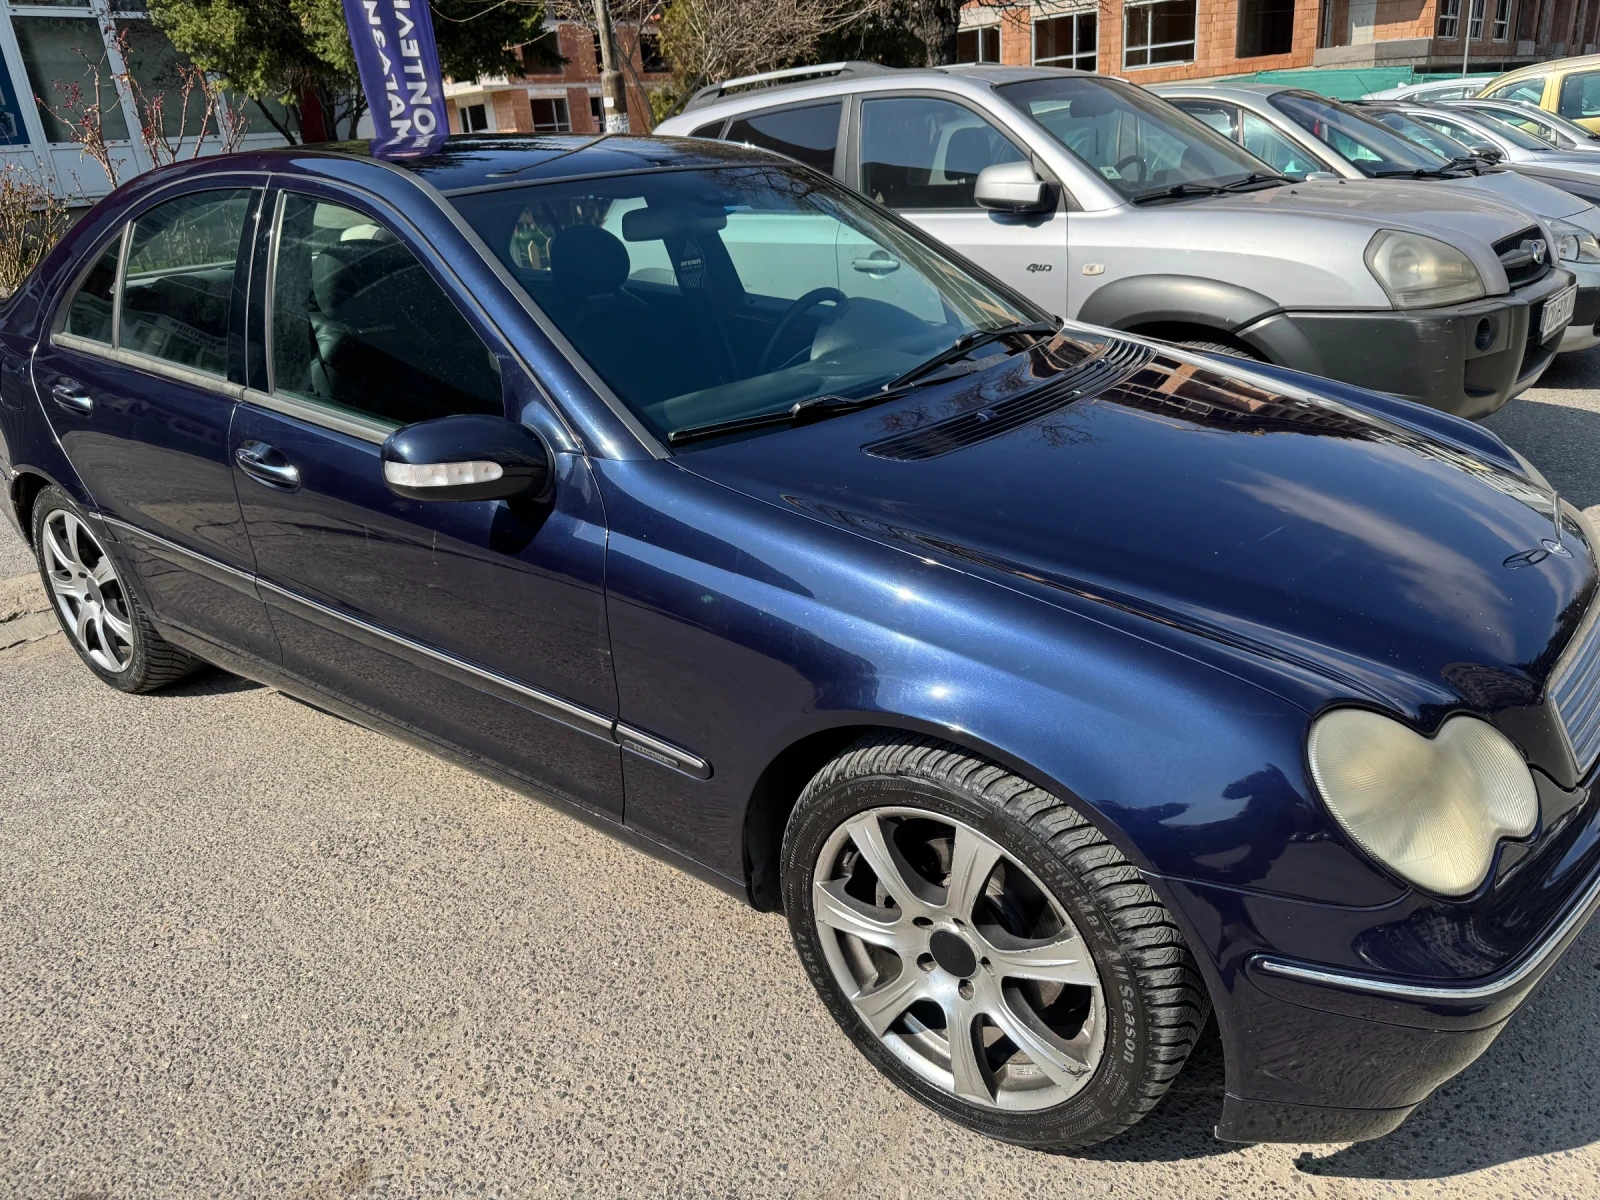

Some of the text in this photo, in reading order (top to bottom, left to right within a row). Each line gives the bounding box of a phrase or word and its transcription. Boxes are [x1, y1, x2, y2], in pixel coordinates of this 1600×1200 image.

[681, 258, 701, 267] areon
[1026, 263, 1052, 273] 4WD
[1118, 984, 1137, 1064] Season
